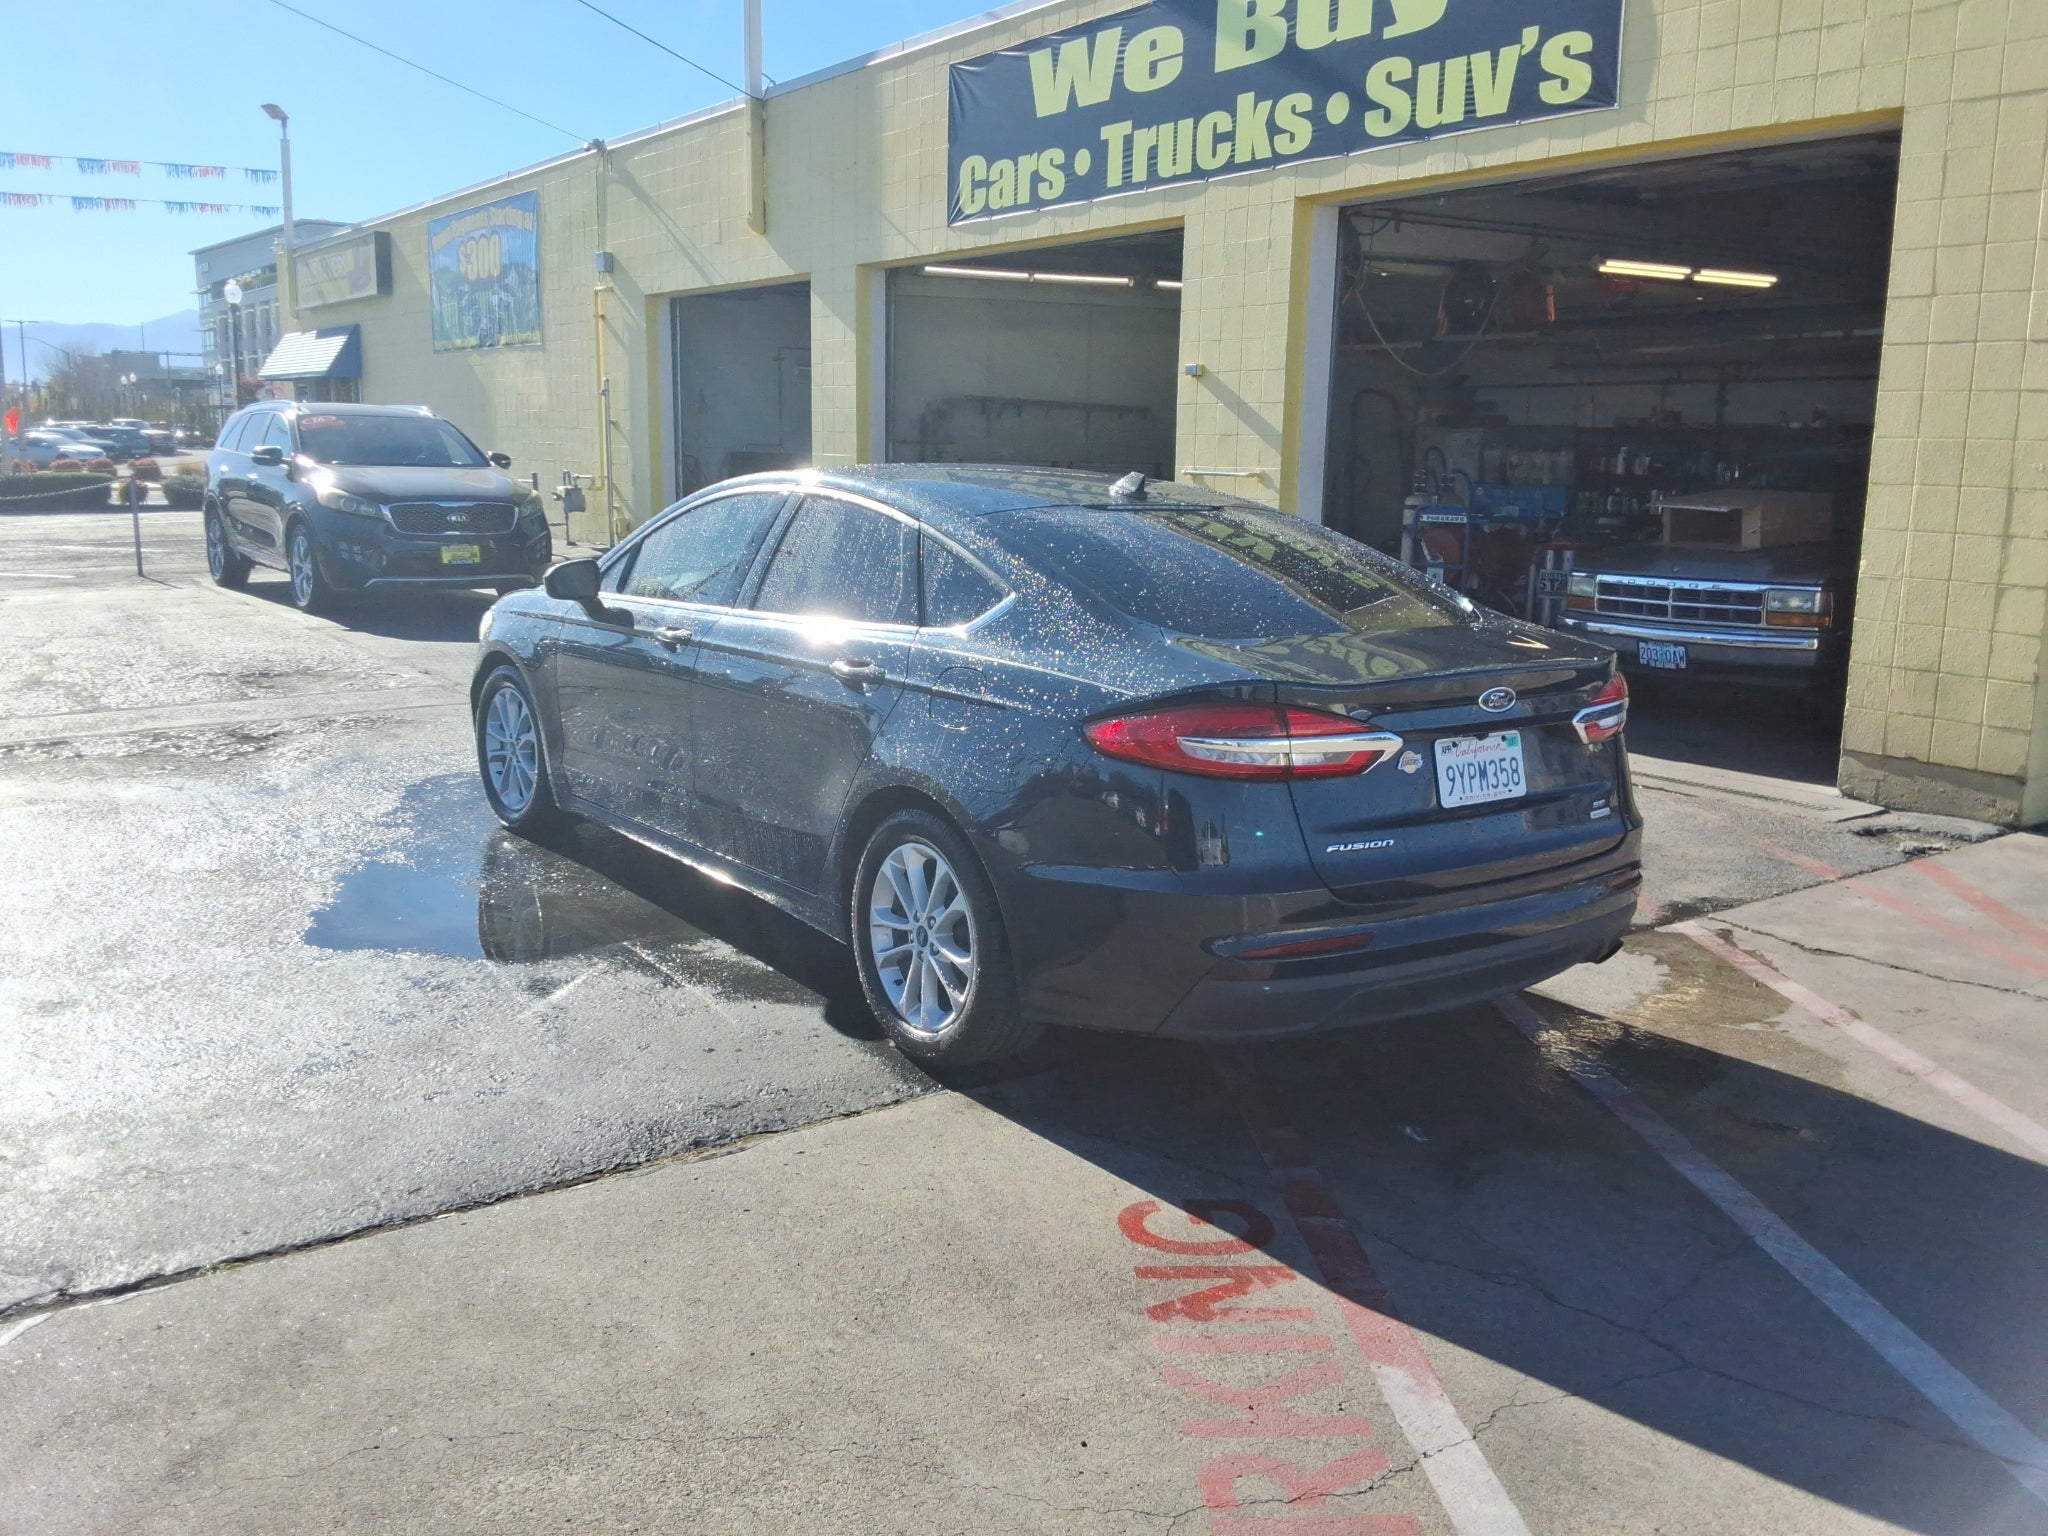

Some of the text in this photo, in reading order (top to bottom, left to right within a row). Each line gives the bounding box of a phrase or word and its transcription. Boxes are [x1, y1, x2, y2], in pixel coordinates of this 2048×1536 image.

[1029, 0, 1450, 118] We Buy
[960, 26, 1594, 215] Cars Trucks Suv's
[458, 232, 501, 281] $300
[1627, 579, 1722, 590] DODGE
[1640, 646, 1659, 662] 203
[1488, 692, 1511, 707] Ford
[1455, 741, 1507, 759] California
[1446, 757, 1521, 797] 9YPM358
[1326, 839, 1394, 853] FUSION
